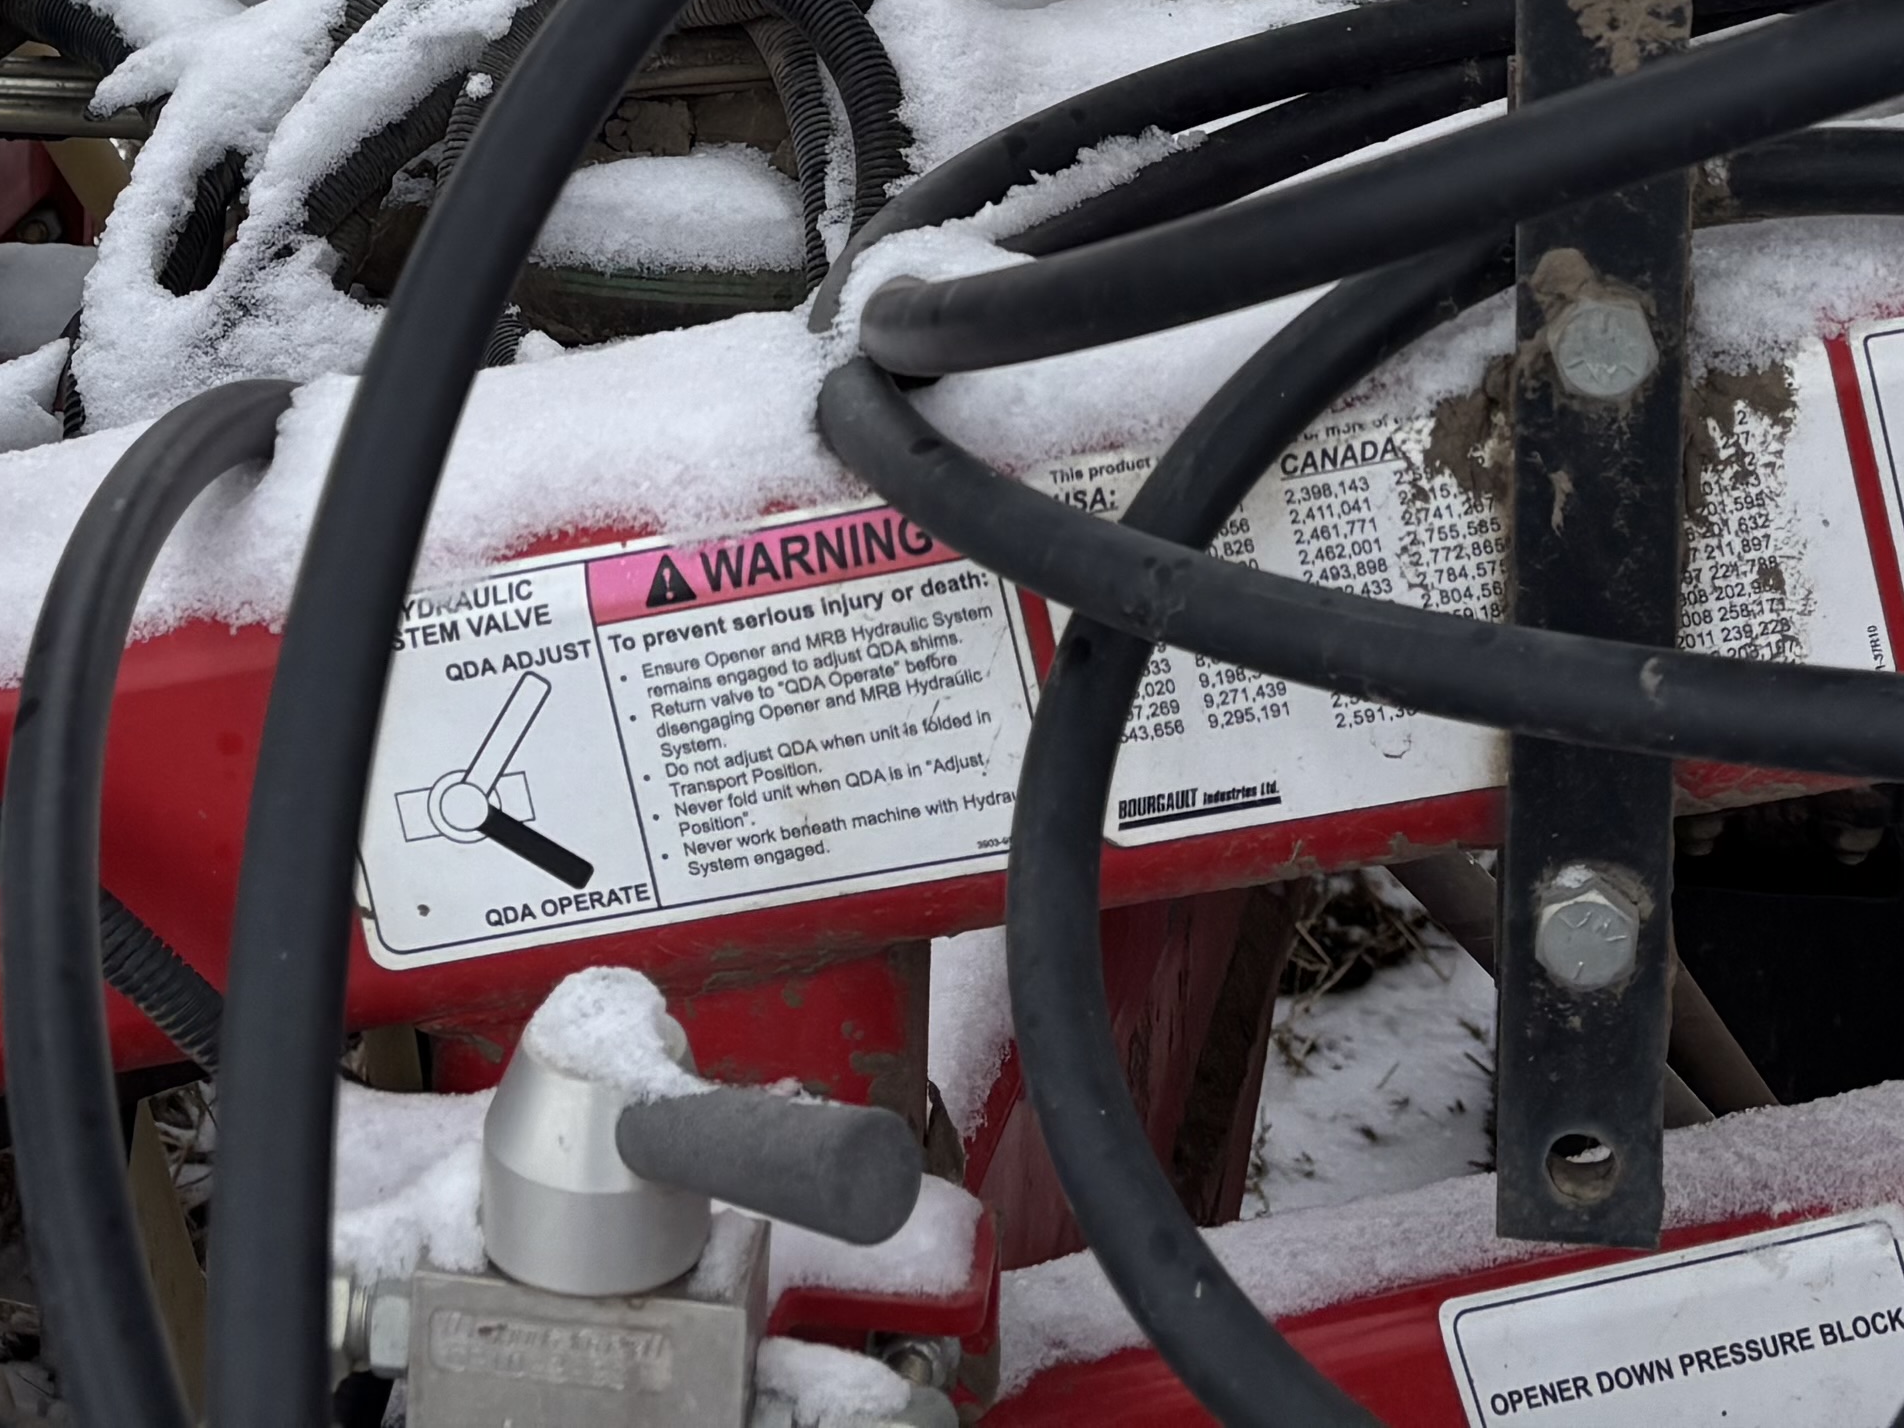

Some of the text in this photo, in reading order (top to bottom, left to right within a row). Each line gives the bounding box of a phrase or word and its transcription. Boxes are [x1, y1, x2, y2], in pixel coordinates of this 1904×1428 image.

[1049, 468, 1083, 484] This
[1088, 456, 1151, 480] product
[1289, 497, 1372, 525] 2,411,041
[1294, 517, 1378, 546] 2,461,771
[700, 517, 934, 592] WARNING
[1299, 537, 1383, 566] 2,462,001
[401, 579, 533, 622] YDRAULIC
[609, 571, 989, 654] To prevent serious injury or death:
[1421, 582, 1504, 609] 2,804,56
[392, 604, 552, 652] STEM VALVE
[641, 604, 993, 680] Ensure Opener and MRB Hydraulic System
[446, 639, 591, 681] QDA ADJUST
[647, 633, 962, 699] remains engaged to adjust QDA shims.
[652, 653, 958, 719] Return valve to "QDA Operate" before
[656, 668, 983, 740] disengaging Opener and MRB Hydraulic
[1204, 681, 1288, 709] 9,271,439
[1208, 702, 1291, 729] 9,295,191
[661, 736, 727, 760] System.
[666, 709, 991, 779] Do not adjust QDA when unit is folded in
[670, 760, 823, 799] Transport Position.
[674, 797, 722, 817] Never
[727, 791, 758, 808] fold
[763, 784, 793, 803] unit
[797, 776, 842, 796] when
[846, 767, 886, 788] QDA
[889, 765, 904, 782] is
[907, 761, 923, 777] in
[1118, 787, 1198, 819] BOURGAULT
[1260, 780, 1280, 796] Ltd.
[679, 811, 755, 838] Position".
[683, 837, 732, 857] Never
[737, 827, 777, 847] work
[781, 819, 848, 840] beneath
[852, 805, 922, 830] machine
[926, 797, 959, 816] with
[688, 842, 830, 877] System engaged.
[485, 883, 650, 926] QDA OPERATE
[1491, 1376, 1592, 1416] OPENER
[1596, 1358, 1675, 1394] DOWN
[1679, 1327, 1814, 1377] PRESSURE
